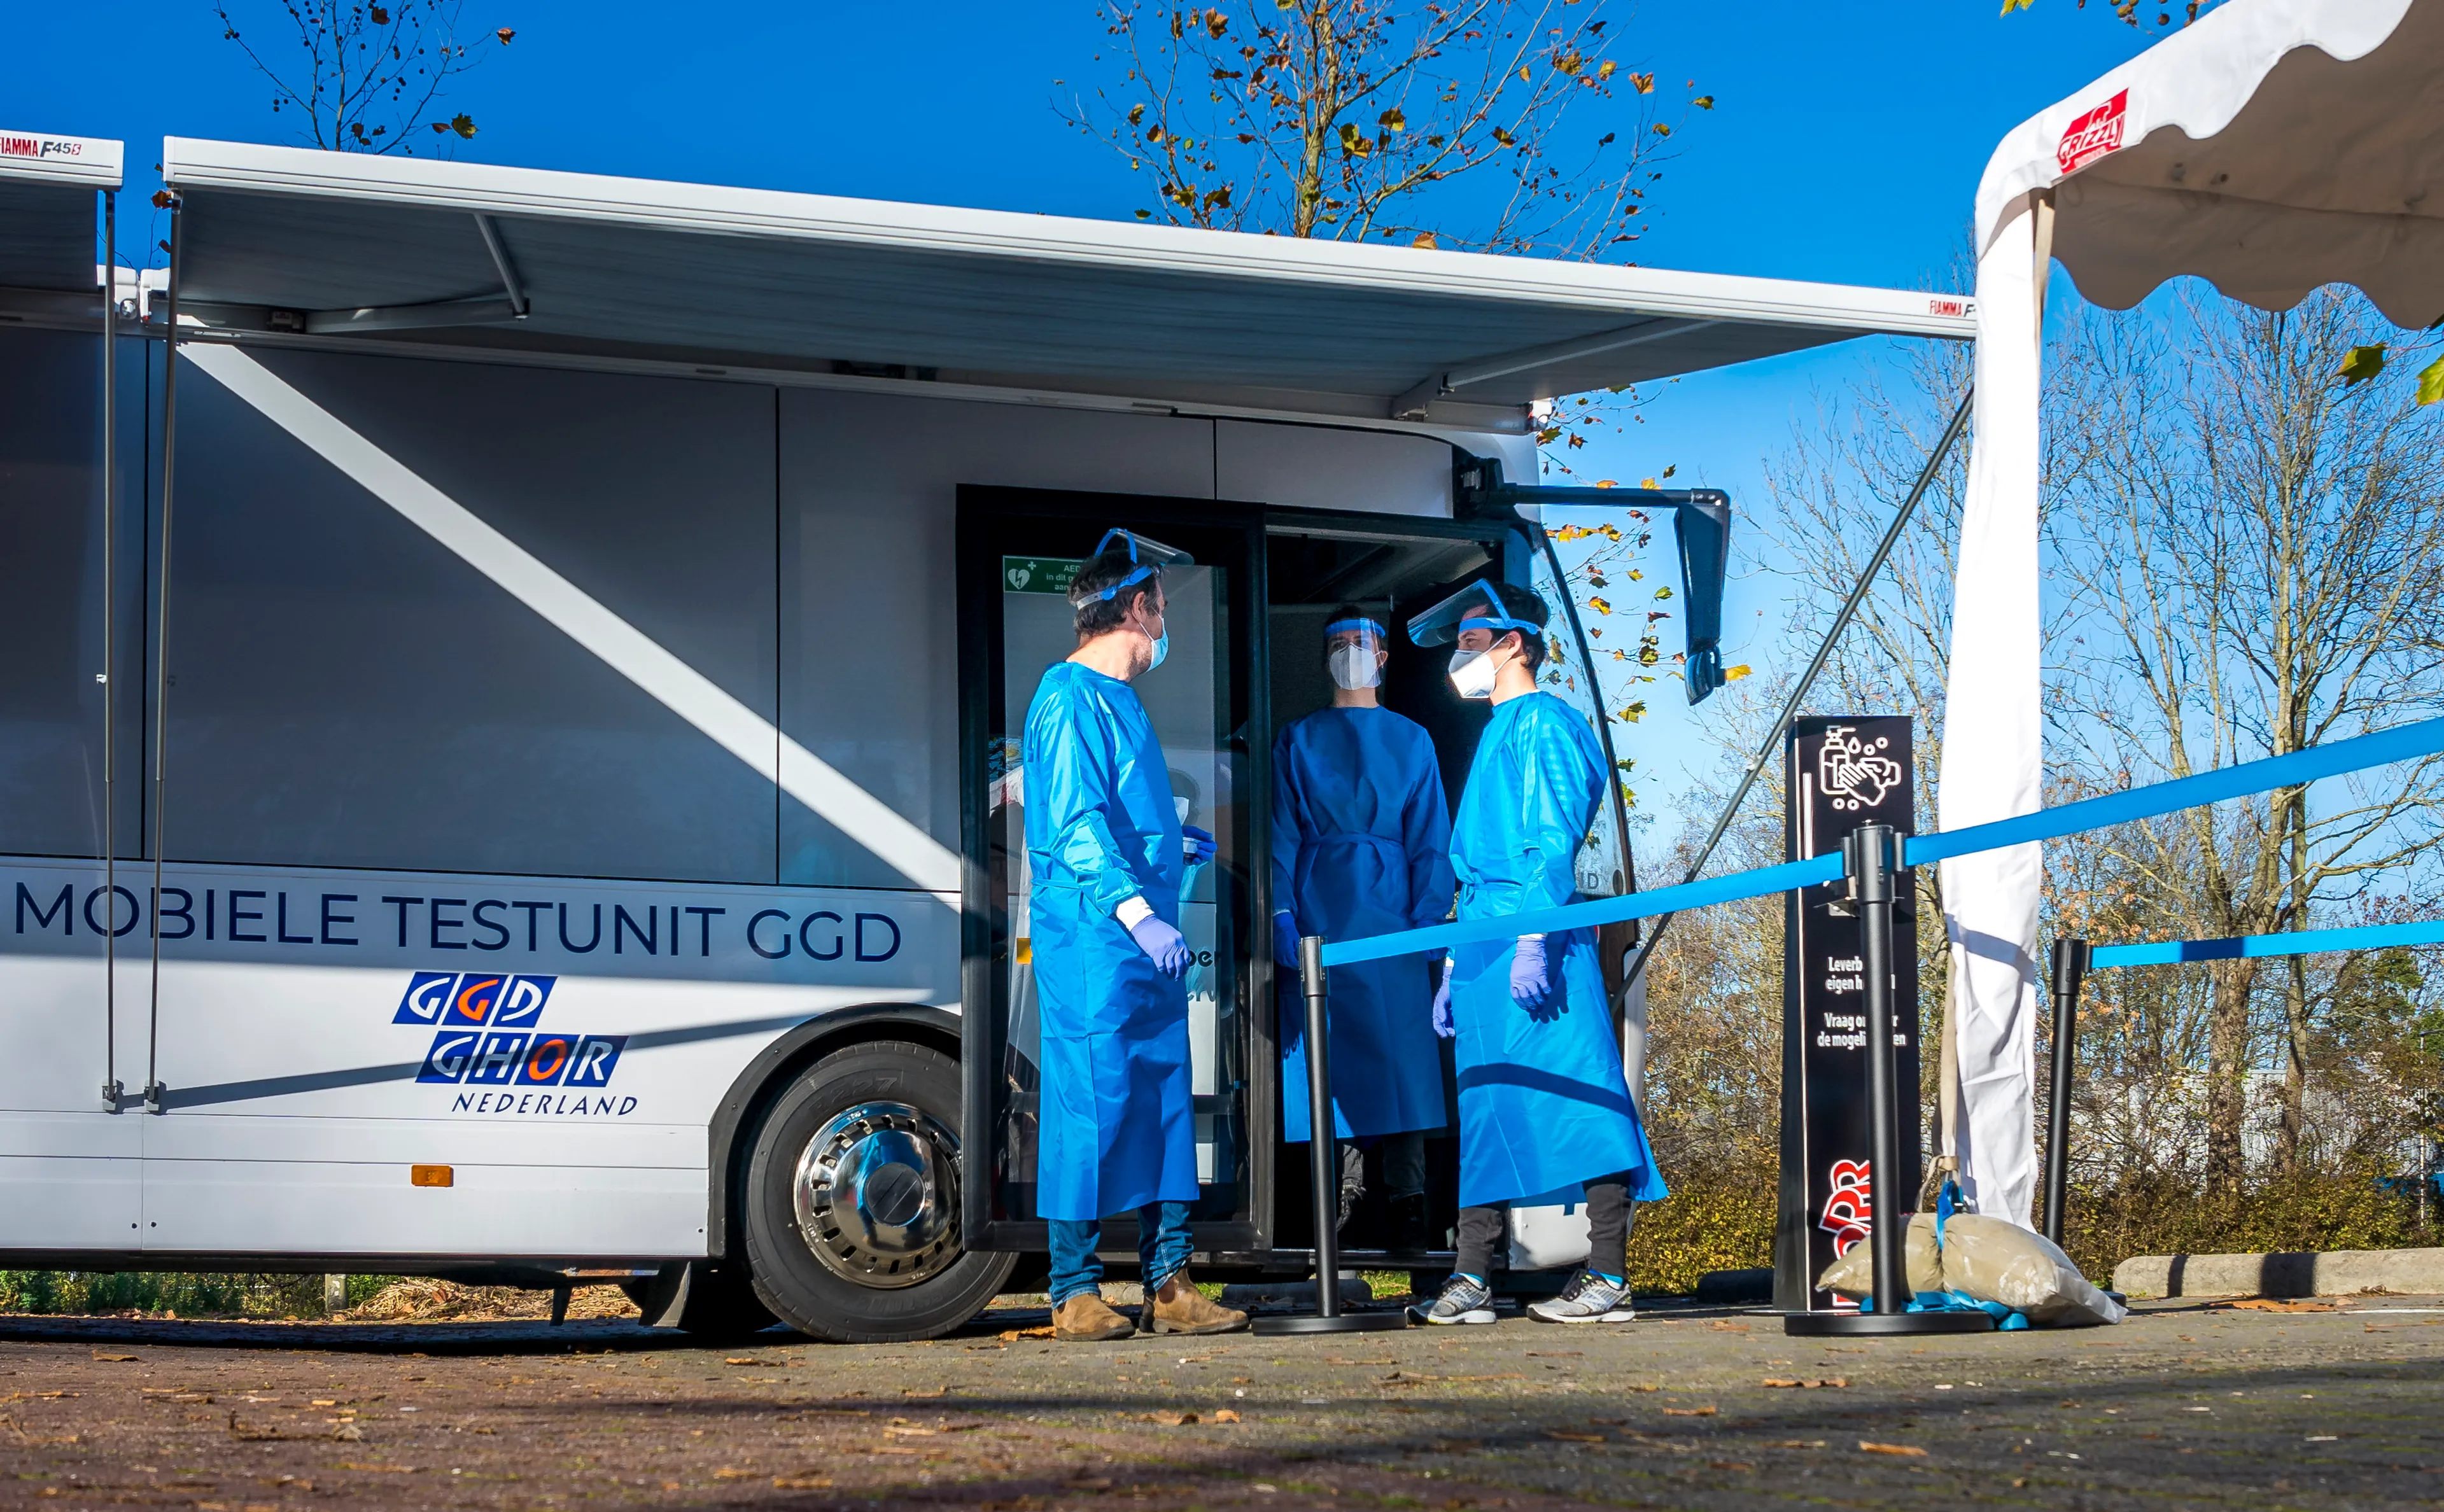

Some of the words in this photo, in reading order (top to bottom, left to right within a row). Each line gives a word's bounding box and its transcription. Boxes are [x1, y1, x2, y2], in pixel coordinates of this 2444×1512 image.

[2058, 110, 2126, 169] GRIZZLY
[15, 882, 359, 946] MOBIELE
[381, 895, 726, 957] TESTUNIT
[747, 909, 902, 963] GGD
[409, 977, 543, 1021] GGD
[1825, 974, 1854, 995] eigen
[1816, 1030, 1830, 1047] de
[1823, 1012, 1855, 1032] Vraag
[432, 1035, 614, 1081] GHOR
[451, 1092, 638, 1116] NEDERLAND
